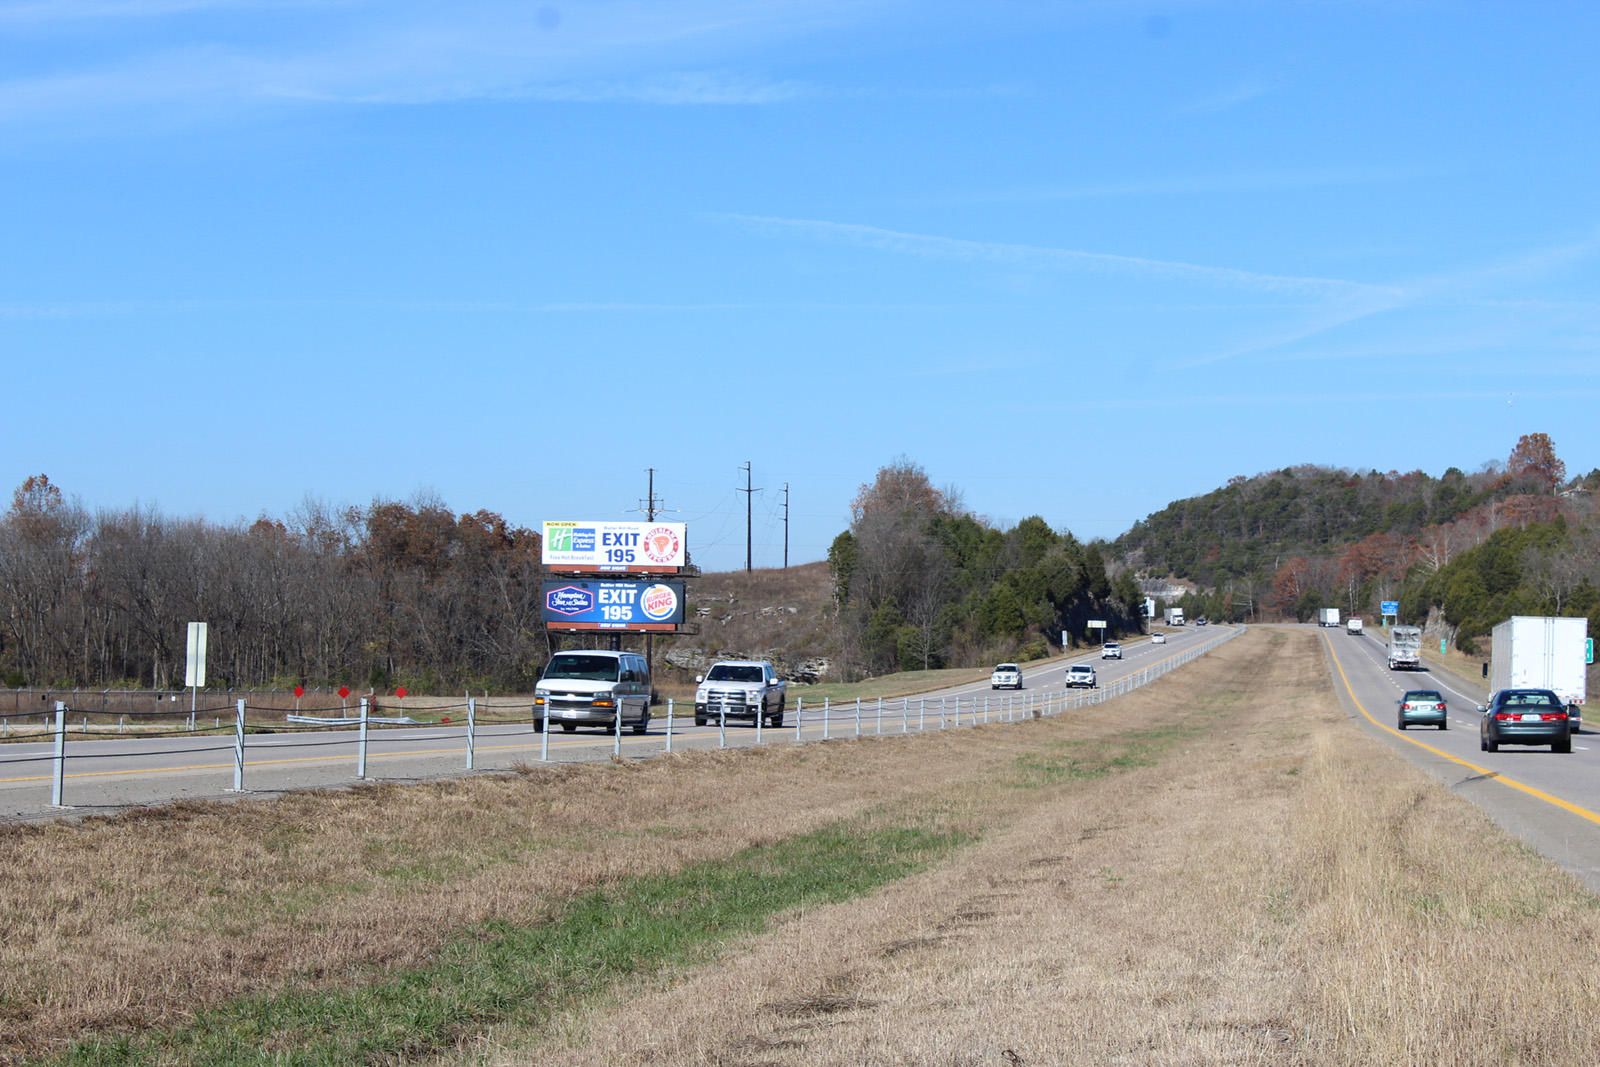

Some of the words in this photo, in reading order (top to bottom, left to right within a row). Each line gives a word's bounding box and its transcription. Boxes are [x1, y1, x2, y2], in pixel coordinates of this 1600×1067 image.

[573, 537, 594, 545] Express
[602, 533, 640, 546] EXIT
[605, 549, 635, 562] 195
[598, 589, 637, 604] EXIT
[646, 591, 671, 604] BURGER
[647, 597, 672, 611] KING
[601, 606, 633, 620] 195
